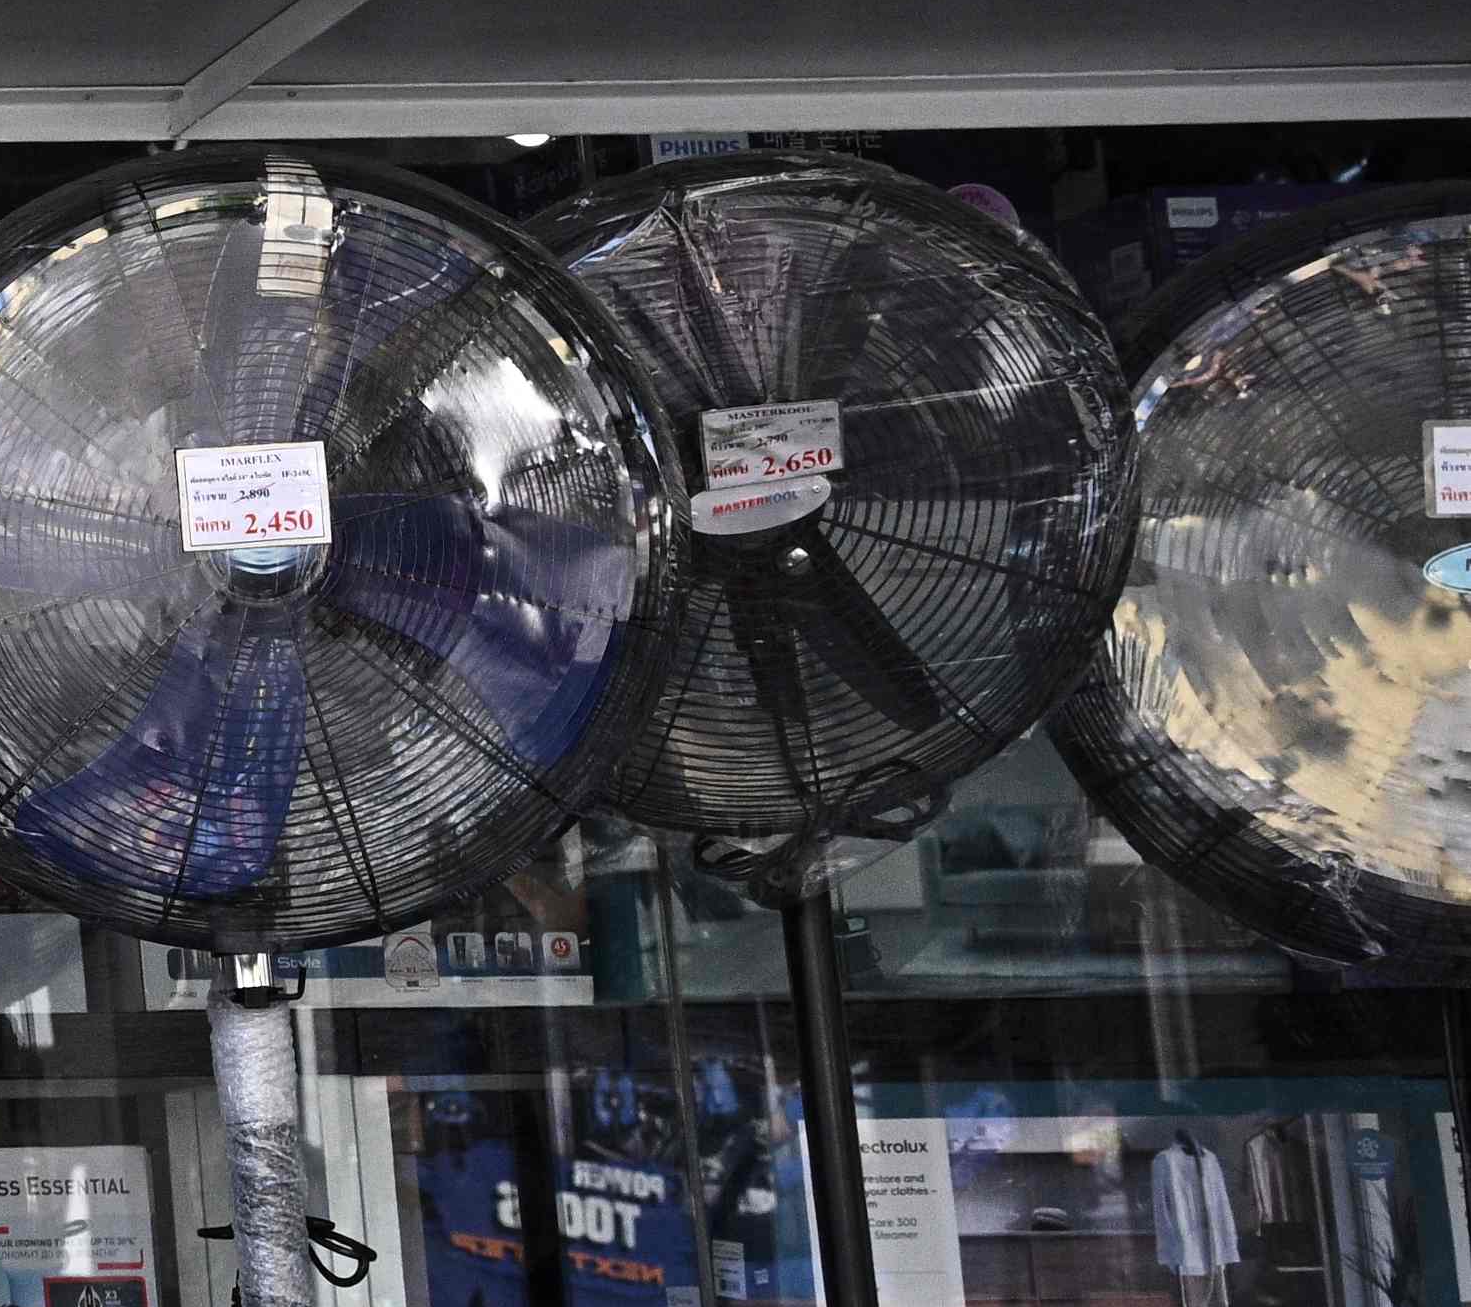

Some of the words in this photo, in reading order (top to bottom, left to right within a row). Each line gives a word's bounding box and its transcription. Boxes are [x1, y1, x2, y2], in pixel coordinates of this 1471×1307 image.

[659, 139, 742, 158] PHILIPS
[728, 406, 813, 421] MASTERKOOL
[220, 453, 283, 467] IMARFLEX
[762, 447, 833, 478] 2,650
[712, 490, 799, 517] MASTERKOOL
[194, 515, 231, 533] พิเศษ
[244, 509, 313, 537] 2,450
[26, 1175, 131, 1197] ESSENTIAL
[904, 1173, 925, 1183] and
[890, 1186, 928, 1196] clothes
[897, 1217, 917, 1227] 300
